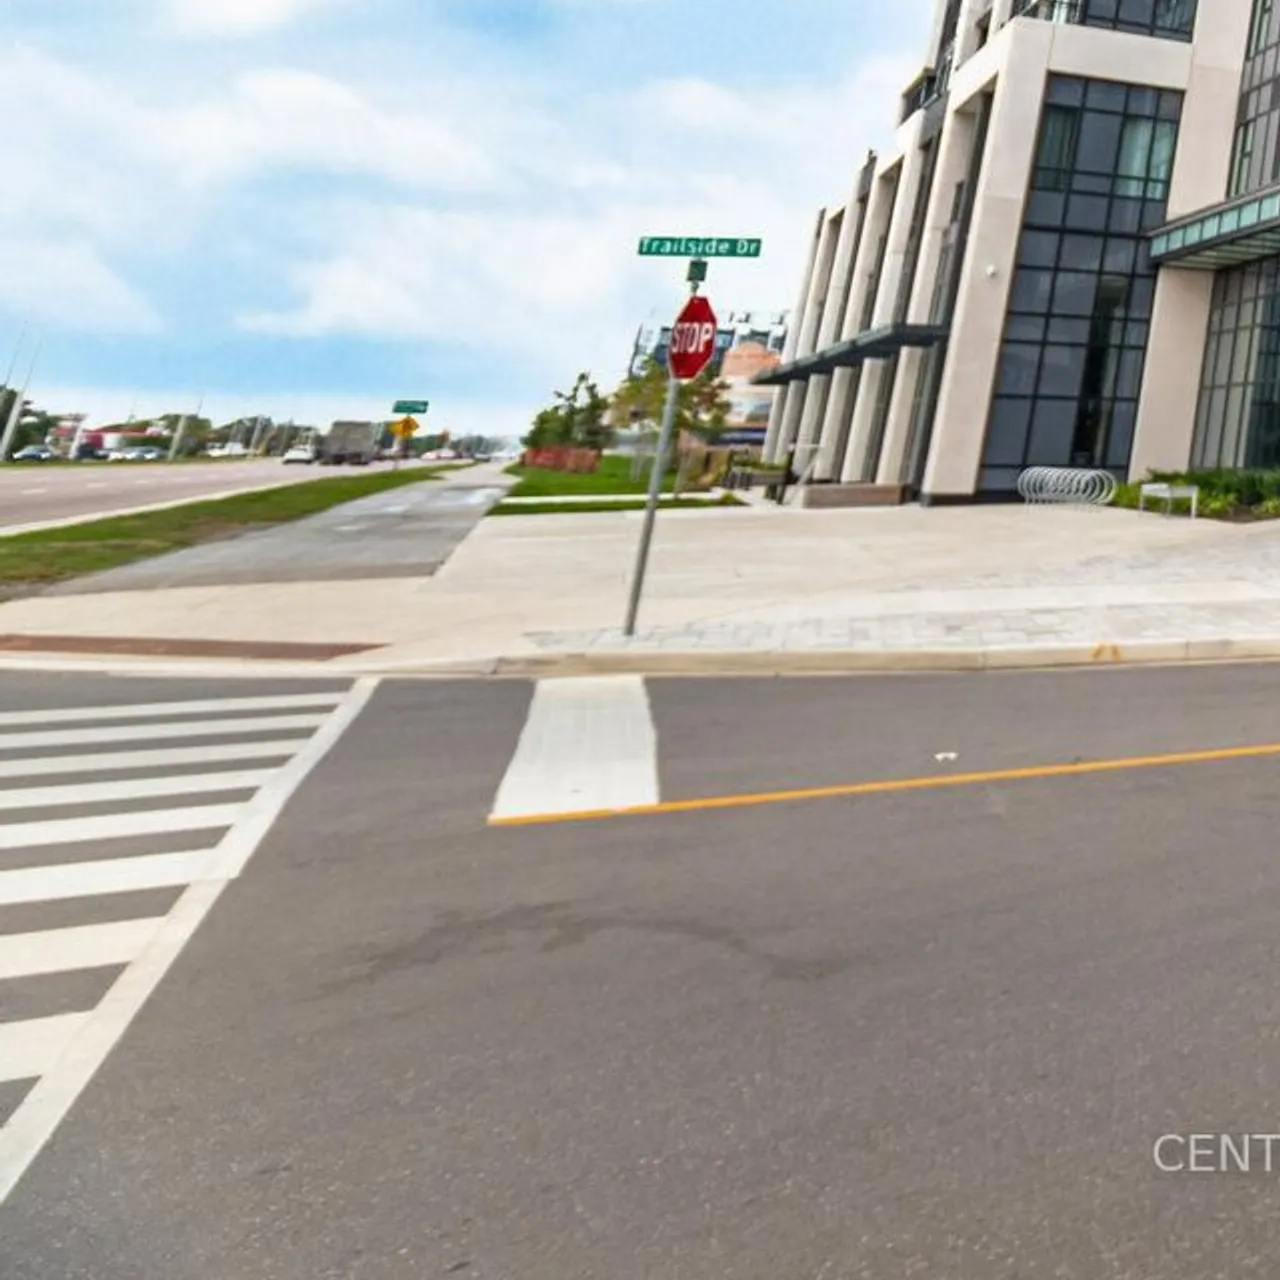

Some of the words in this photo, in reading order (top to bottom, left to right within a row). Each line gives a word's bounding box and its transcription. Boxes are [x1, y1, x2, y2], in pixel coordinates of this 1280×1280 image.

[641, 239, 730, 253] Trailside
[736, 240, 758, 253] Dr
[671, 322, 713, 353] STOP
